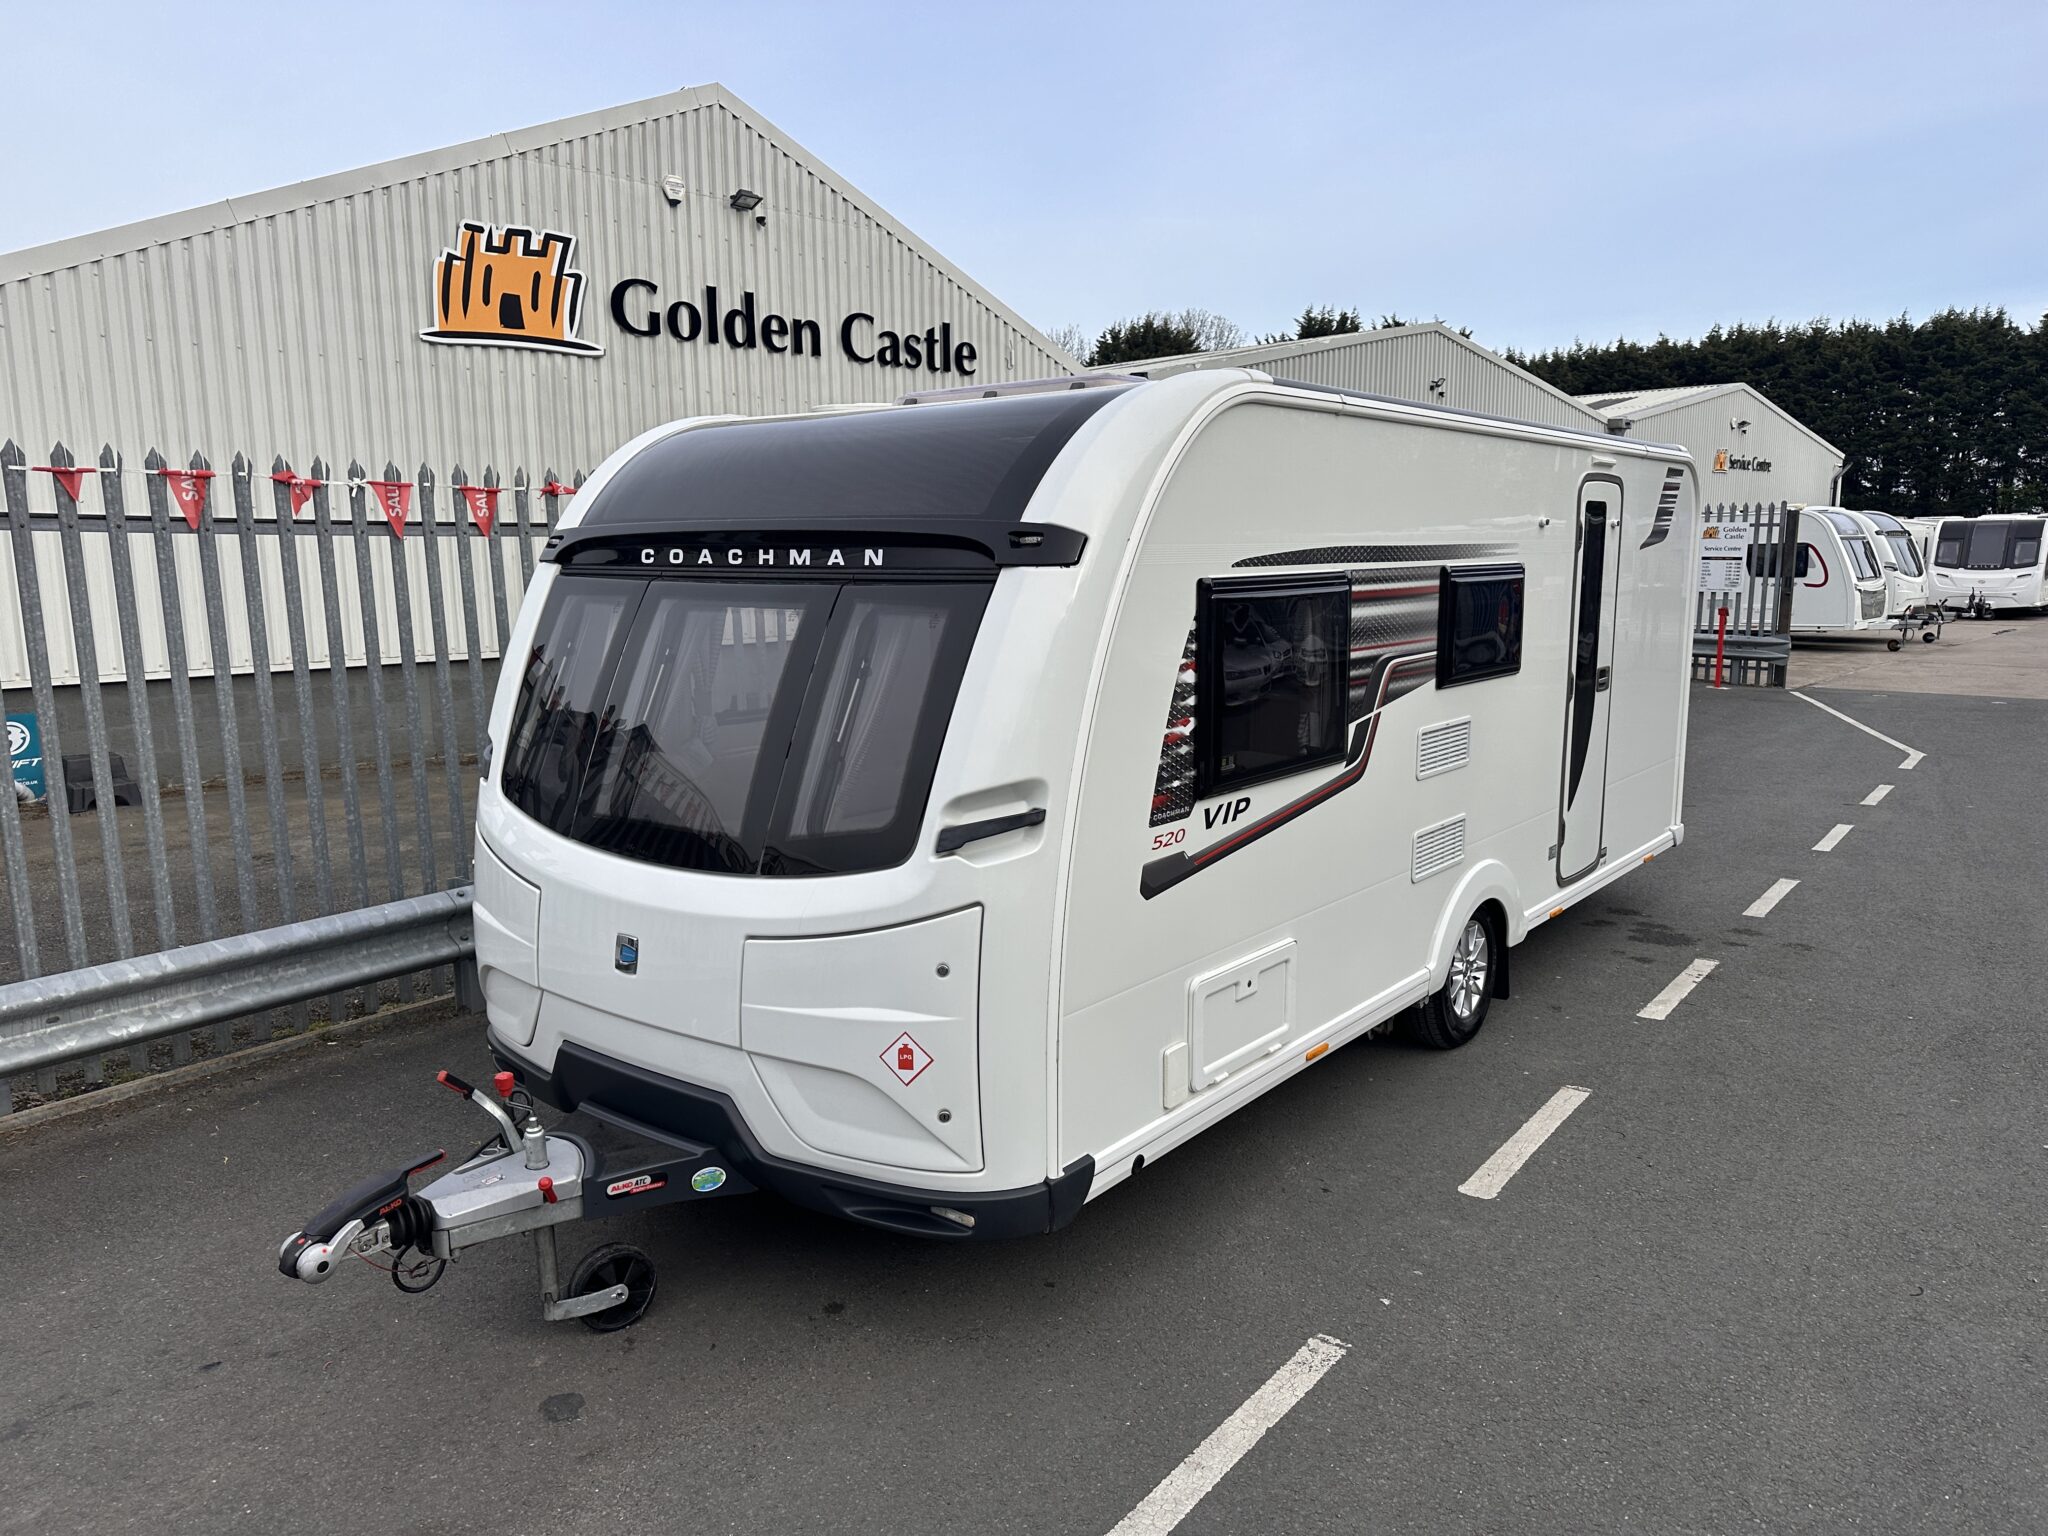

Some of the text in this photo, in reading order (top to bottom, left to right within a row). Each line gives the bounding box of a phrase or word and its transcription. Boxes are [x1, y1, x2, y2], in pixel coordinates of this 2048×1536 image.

[610, 278, 977, 376] Golden Castle
[641, 548, 884, 566] COACHMAN
[1153, 806, 1190, 821] COACHMAN
[1204, 797, 1251, 830] VIP
[1151, 828, 1186, 851] 520
[634, 1177, 648, 1187] ATC
